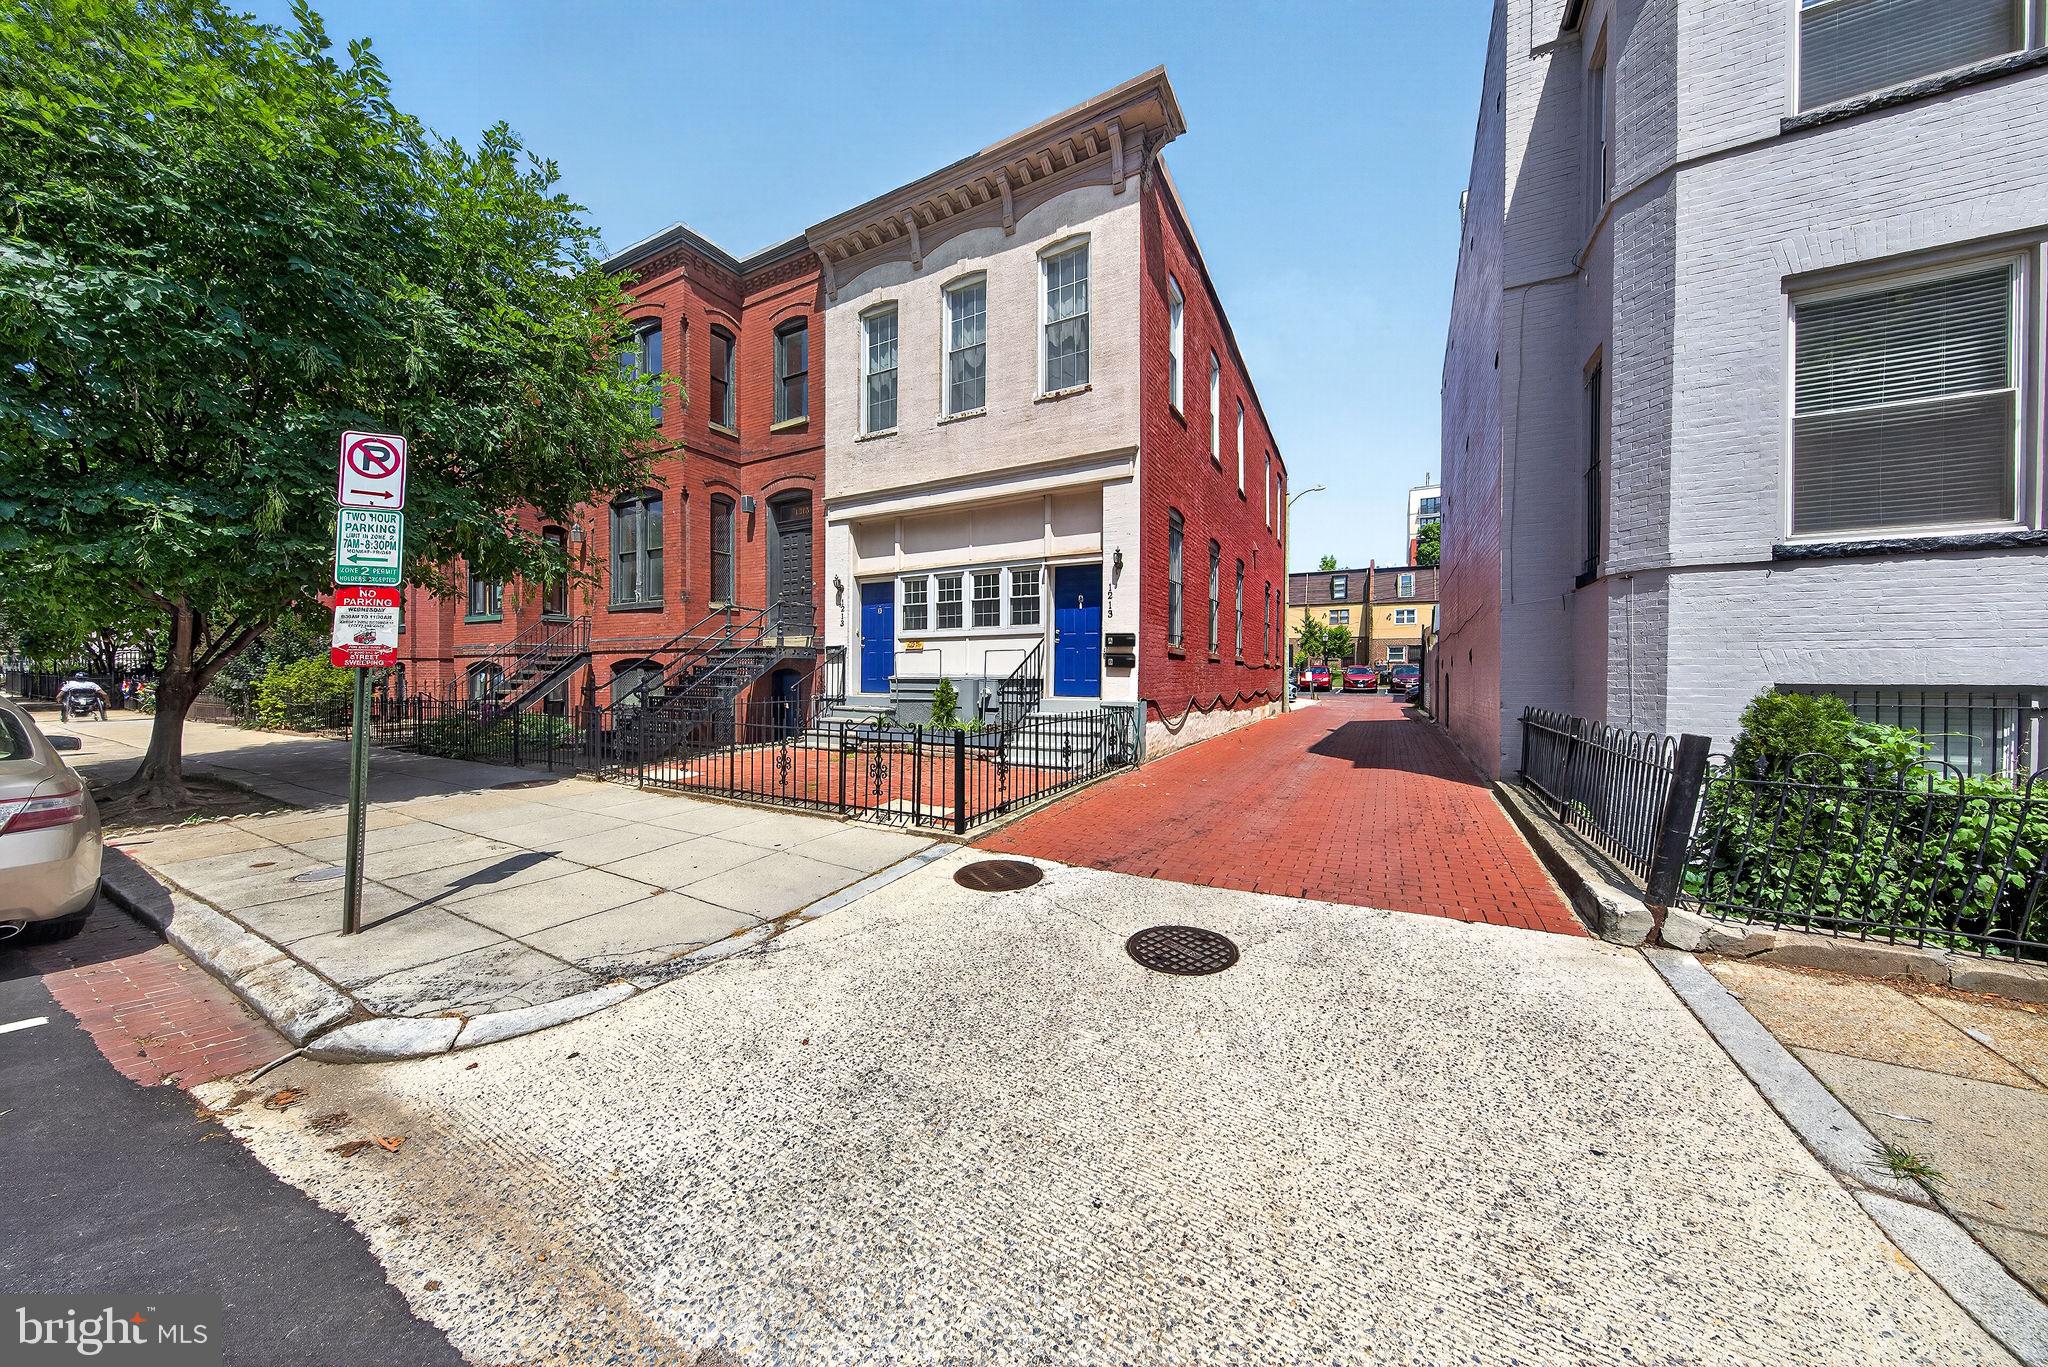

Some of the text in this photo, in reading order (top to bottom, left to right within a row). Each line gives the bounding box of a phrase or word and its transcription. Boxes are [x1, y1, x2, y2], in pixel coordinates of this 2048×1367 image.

[346, 512, 397, 523] TWO HOUR
[345, 523, 397, 534] PARKING
[361, 567, 370, 576] 2
[360, 590, 377, 598] NO
[343, 598, 392, 606] PARKING
